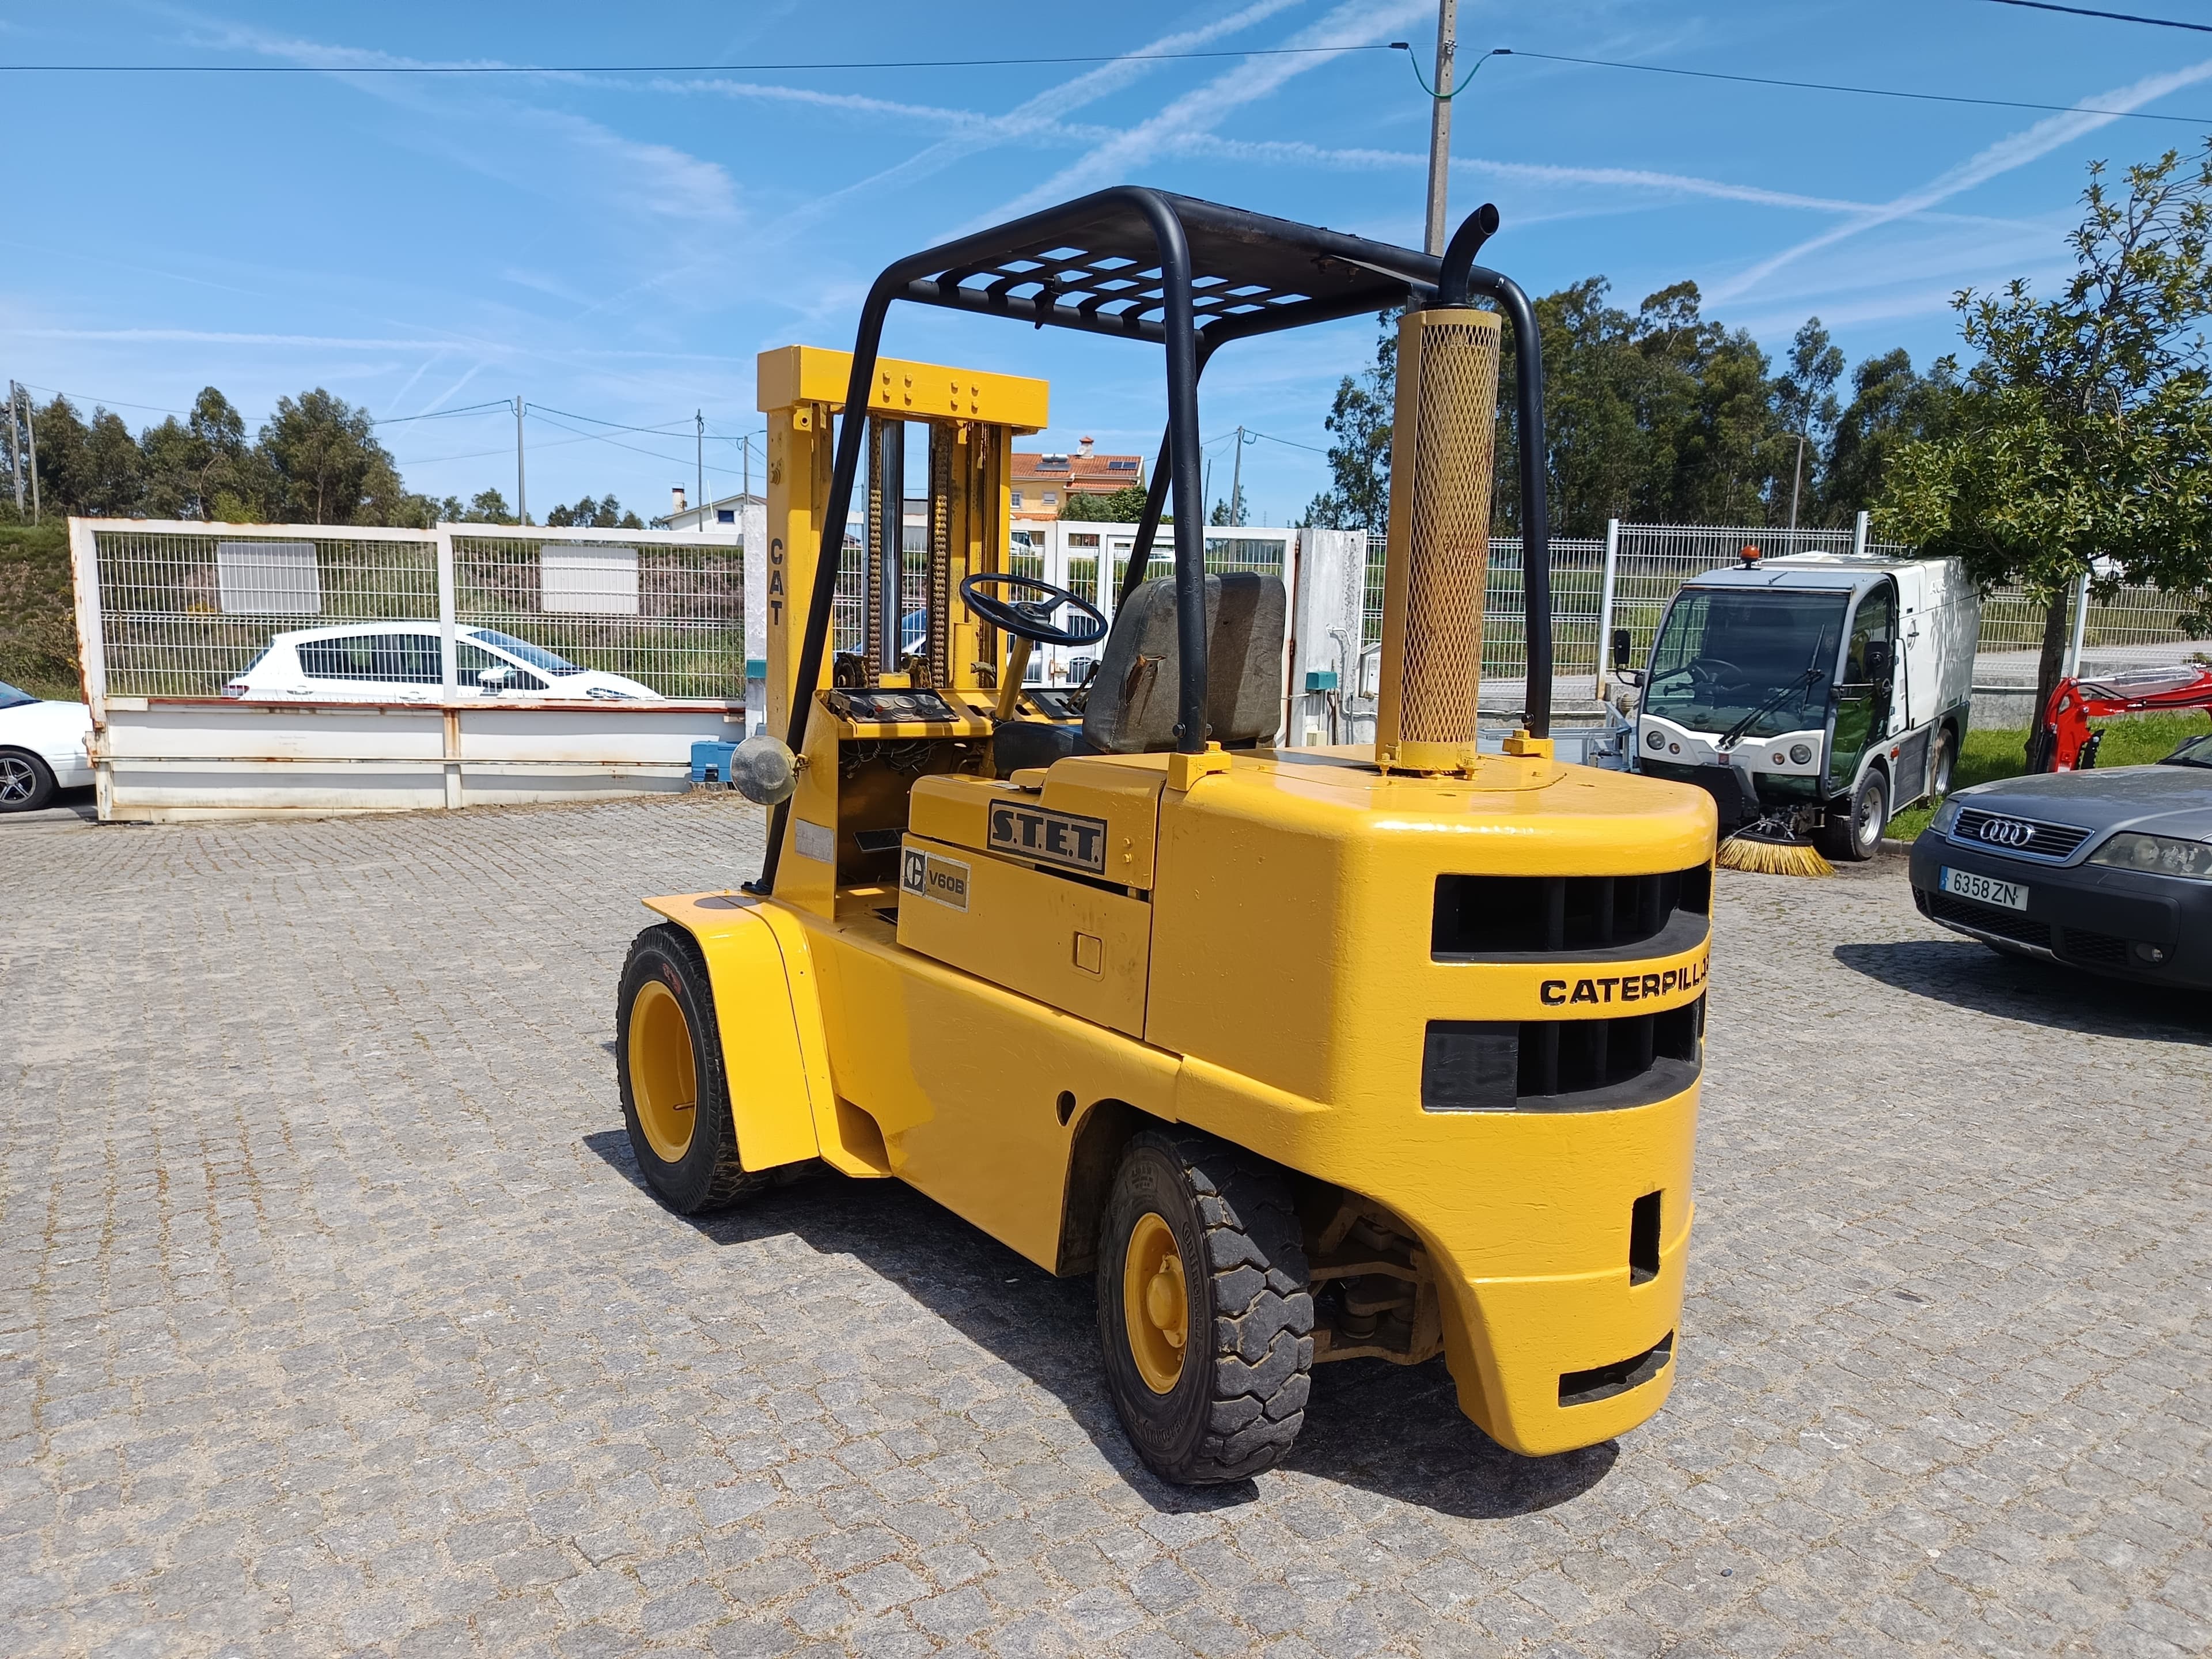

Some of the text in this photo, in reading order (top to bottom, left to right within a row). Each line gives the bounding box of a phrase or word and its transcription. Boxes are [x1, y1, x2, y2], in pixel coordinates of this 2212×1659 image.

[769, 538, 784, 626] CAT
[993, 809, 1100, 863] S.T.E.T.
[929, 869, 965, 895] V60B
[1954, 873, 2017, 906] 6358ZN
